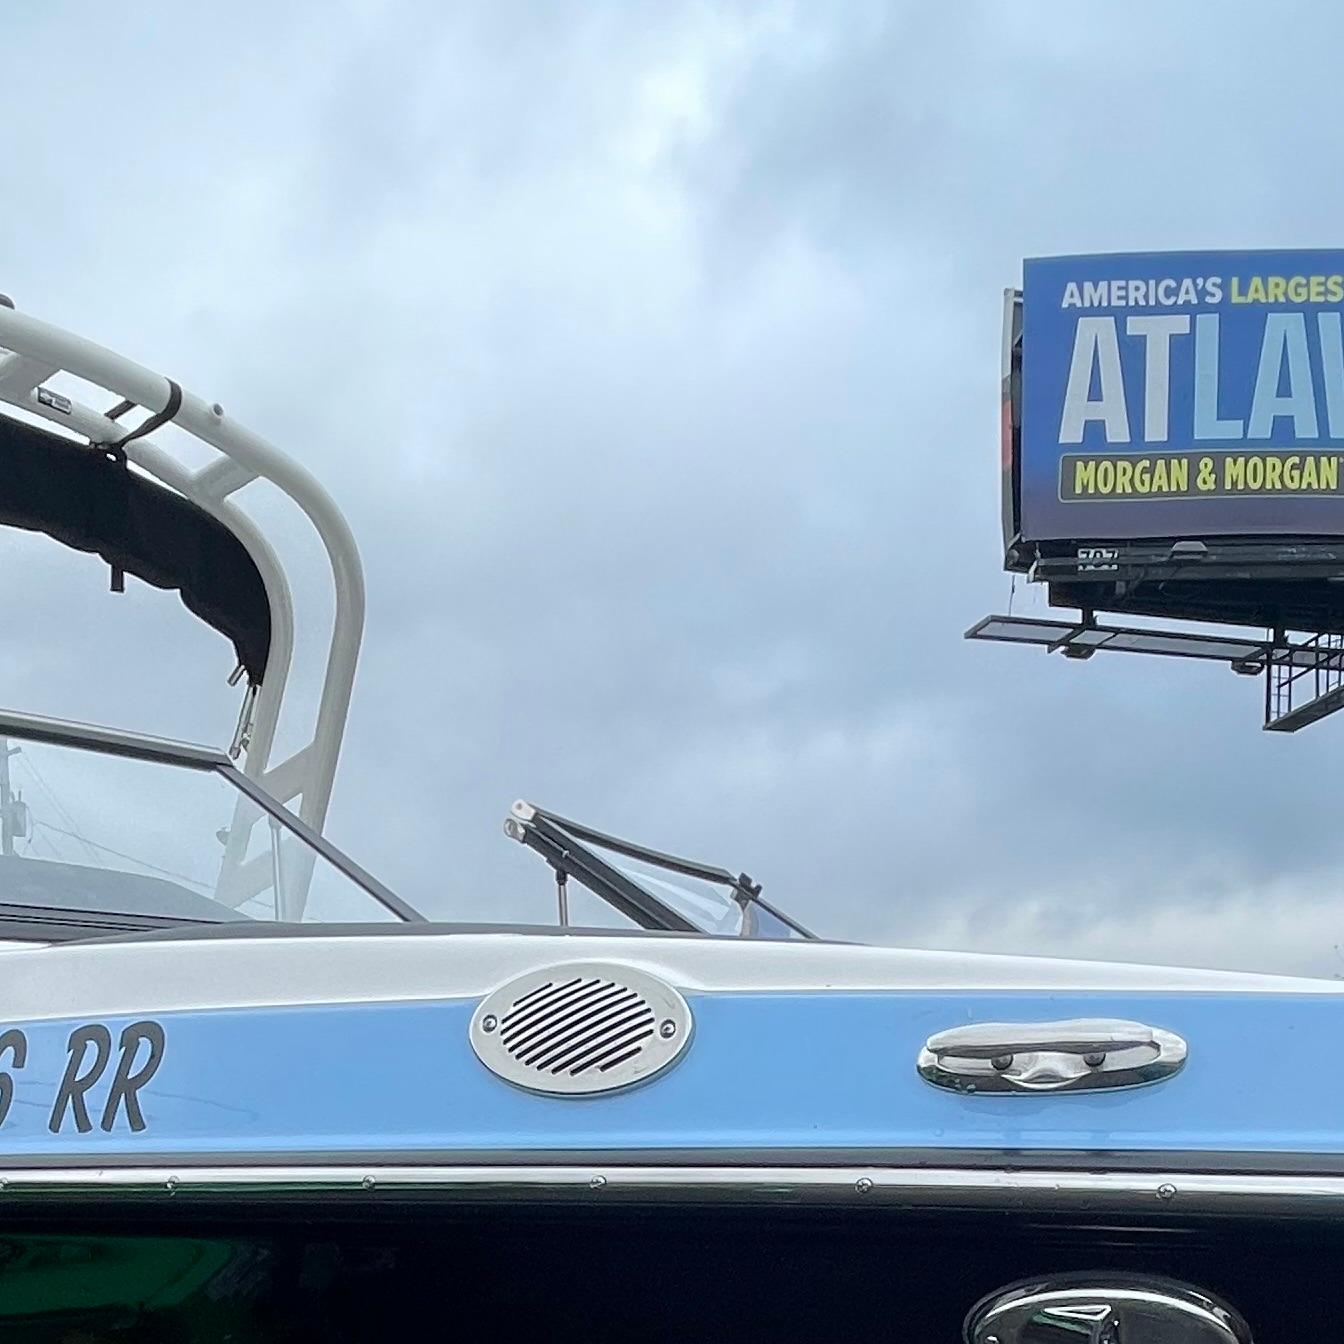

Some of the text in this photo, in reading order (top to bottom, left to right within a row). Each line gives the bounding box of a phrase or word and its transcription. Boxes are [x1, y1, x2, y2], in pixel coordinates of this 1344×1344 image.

[1061, 276, 1223, 308] AMERICA'S
[1074, 455, 1338, 494] MORGAN & MORGAN
[48, 1020, 167, 1135] RR
